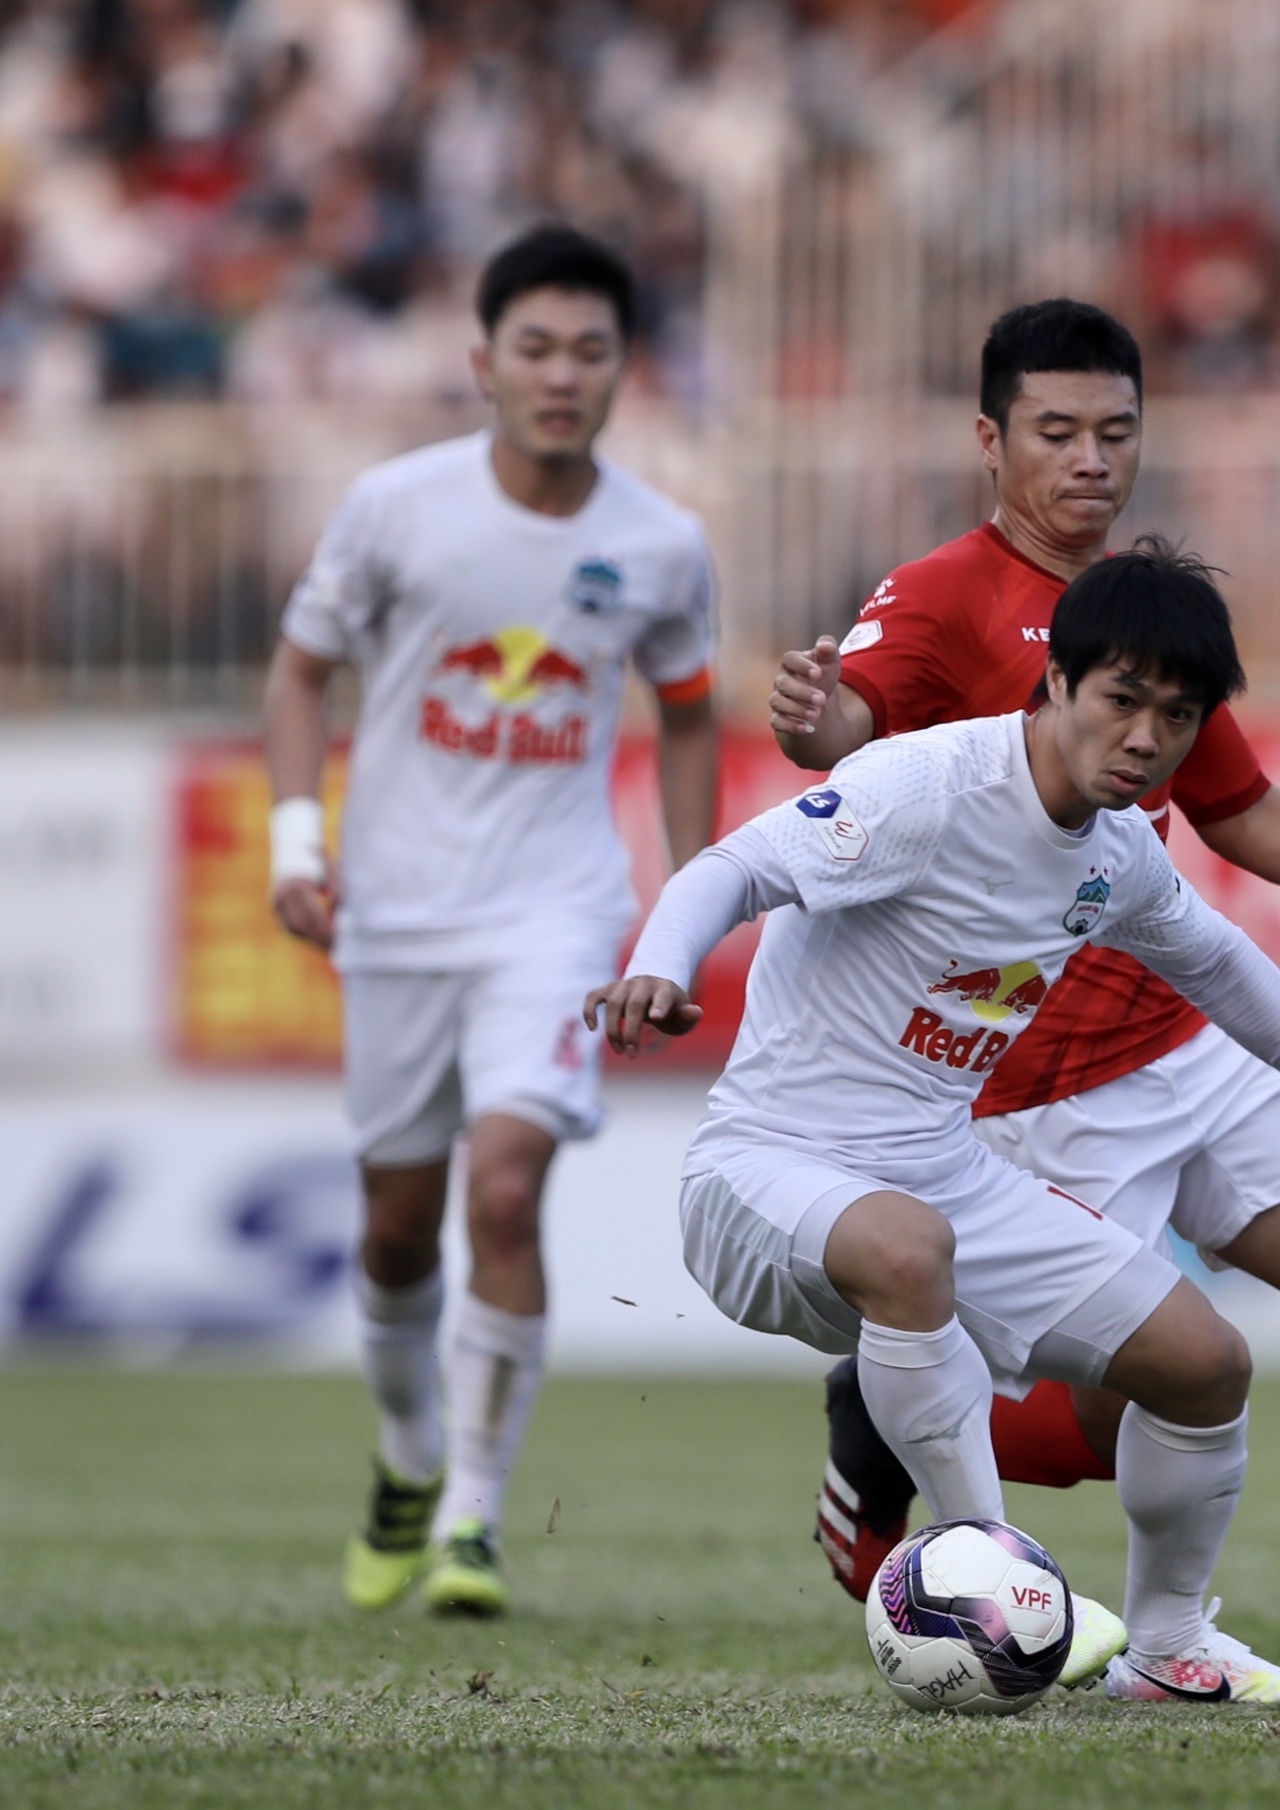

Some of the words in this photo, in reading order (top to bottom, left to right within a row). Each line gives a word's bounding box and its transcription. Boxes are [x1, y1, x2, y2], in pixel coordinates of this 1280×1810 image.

[418, 692, 500, 760] Red
[898, 1006, 989, 1070] Red
[1011, 1585, 1052, 1610] VPF
